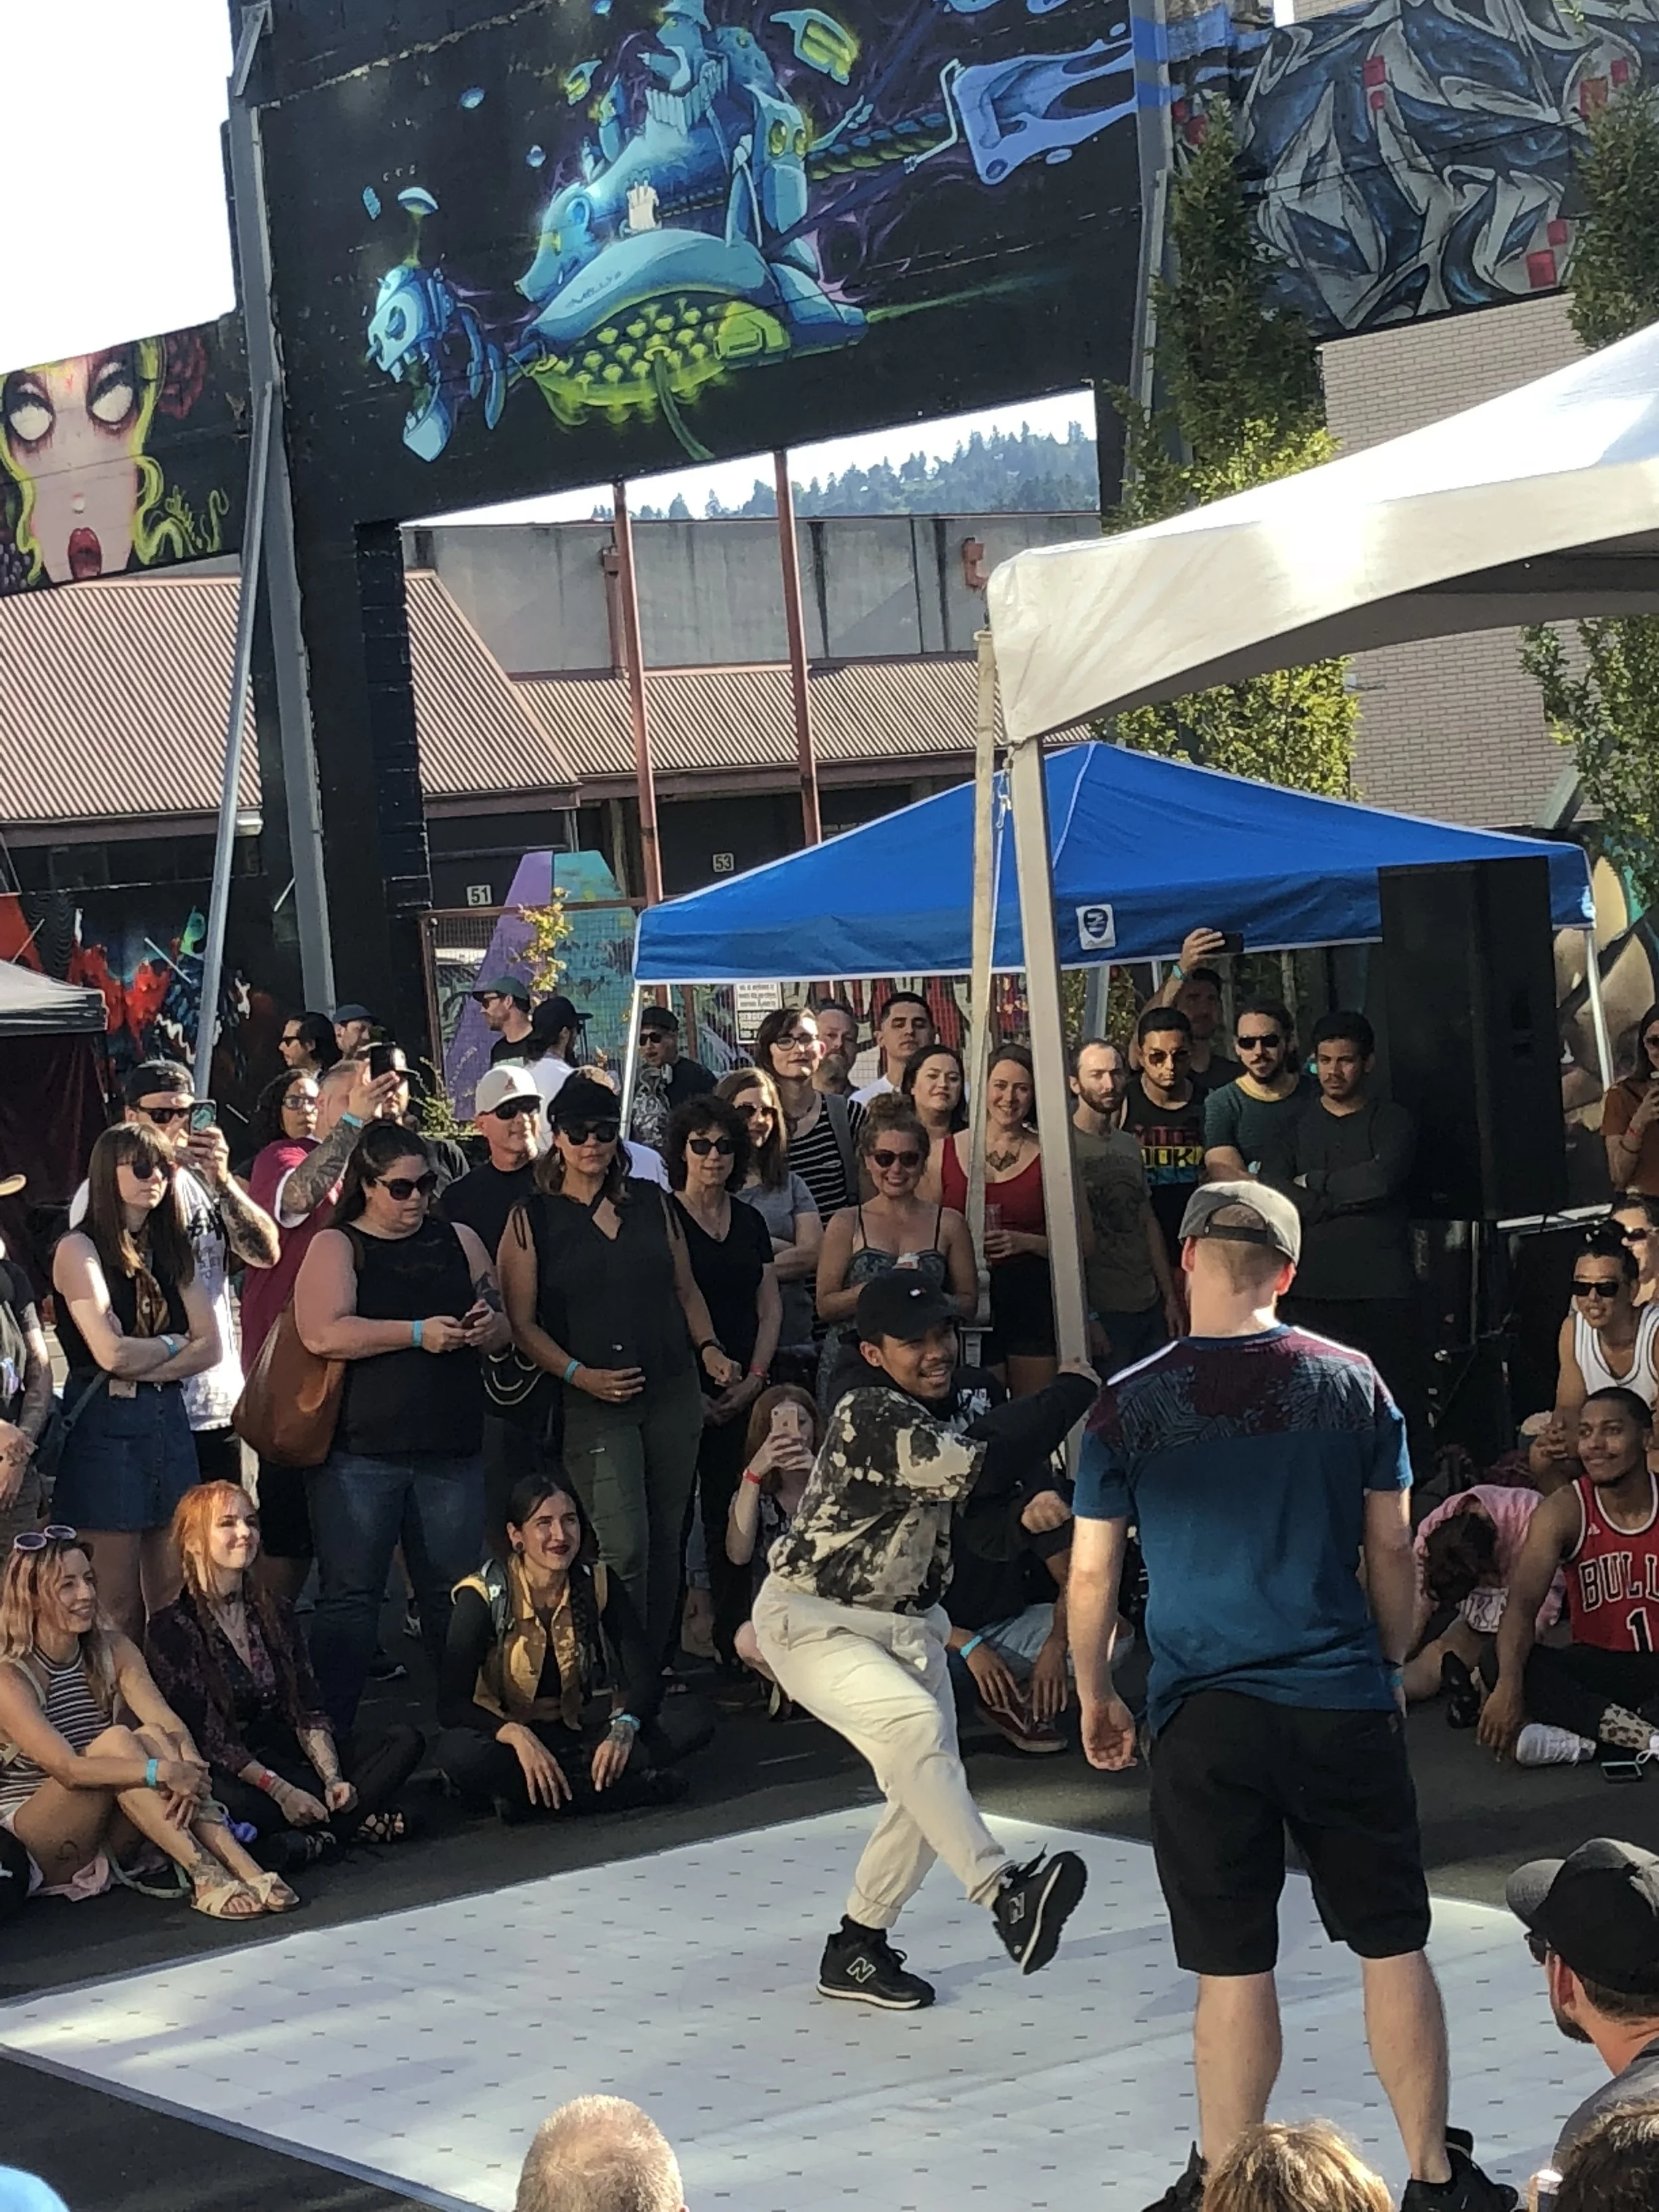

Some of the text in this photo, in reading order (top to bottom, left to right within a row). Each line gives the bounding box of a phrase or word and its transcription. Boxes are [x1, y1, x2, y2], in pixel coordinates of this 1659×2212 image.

[716, 855, 731, 869] 53
[471, 887, 488, 903] 51
[846, 1956, 876, 1984] N
